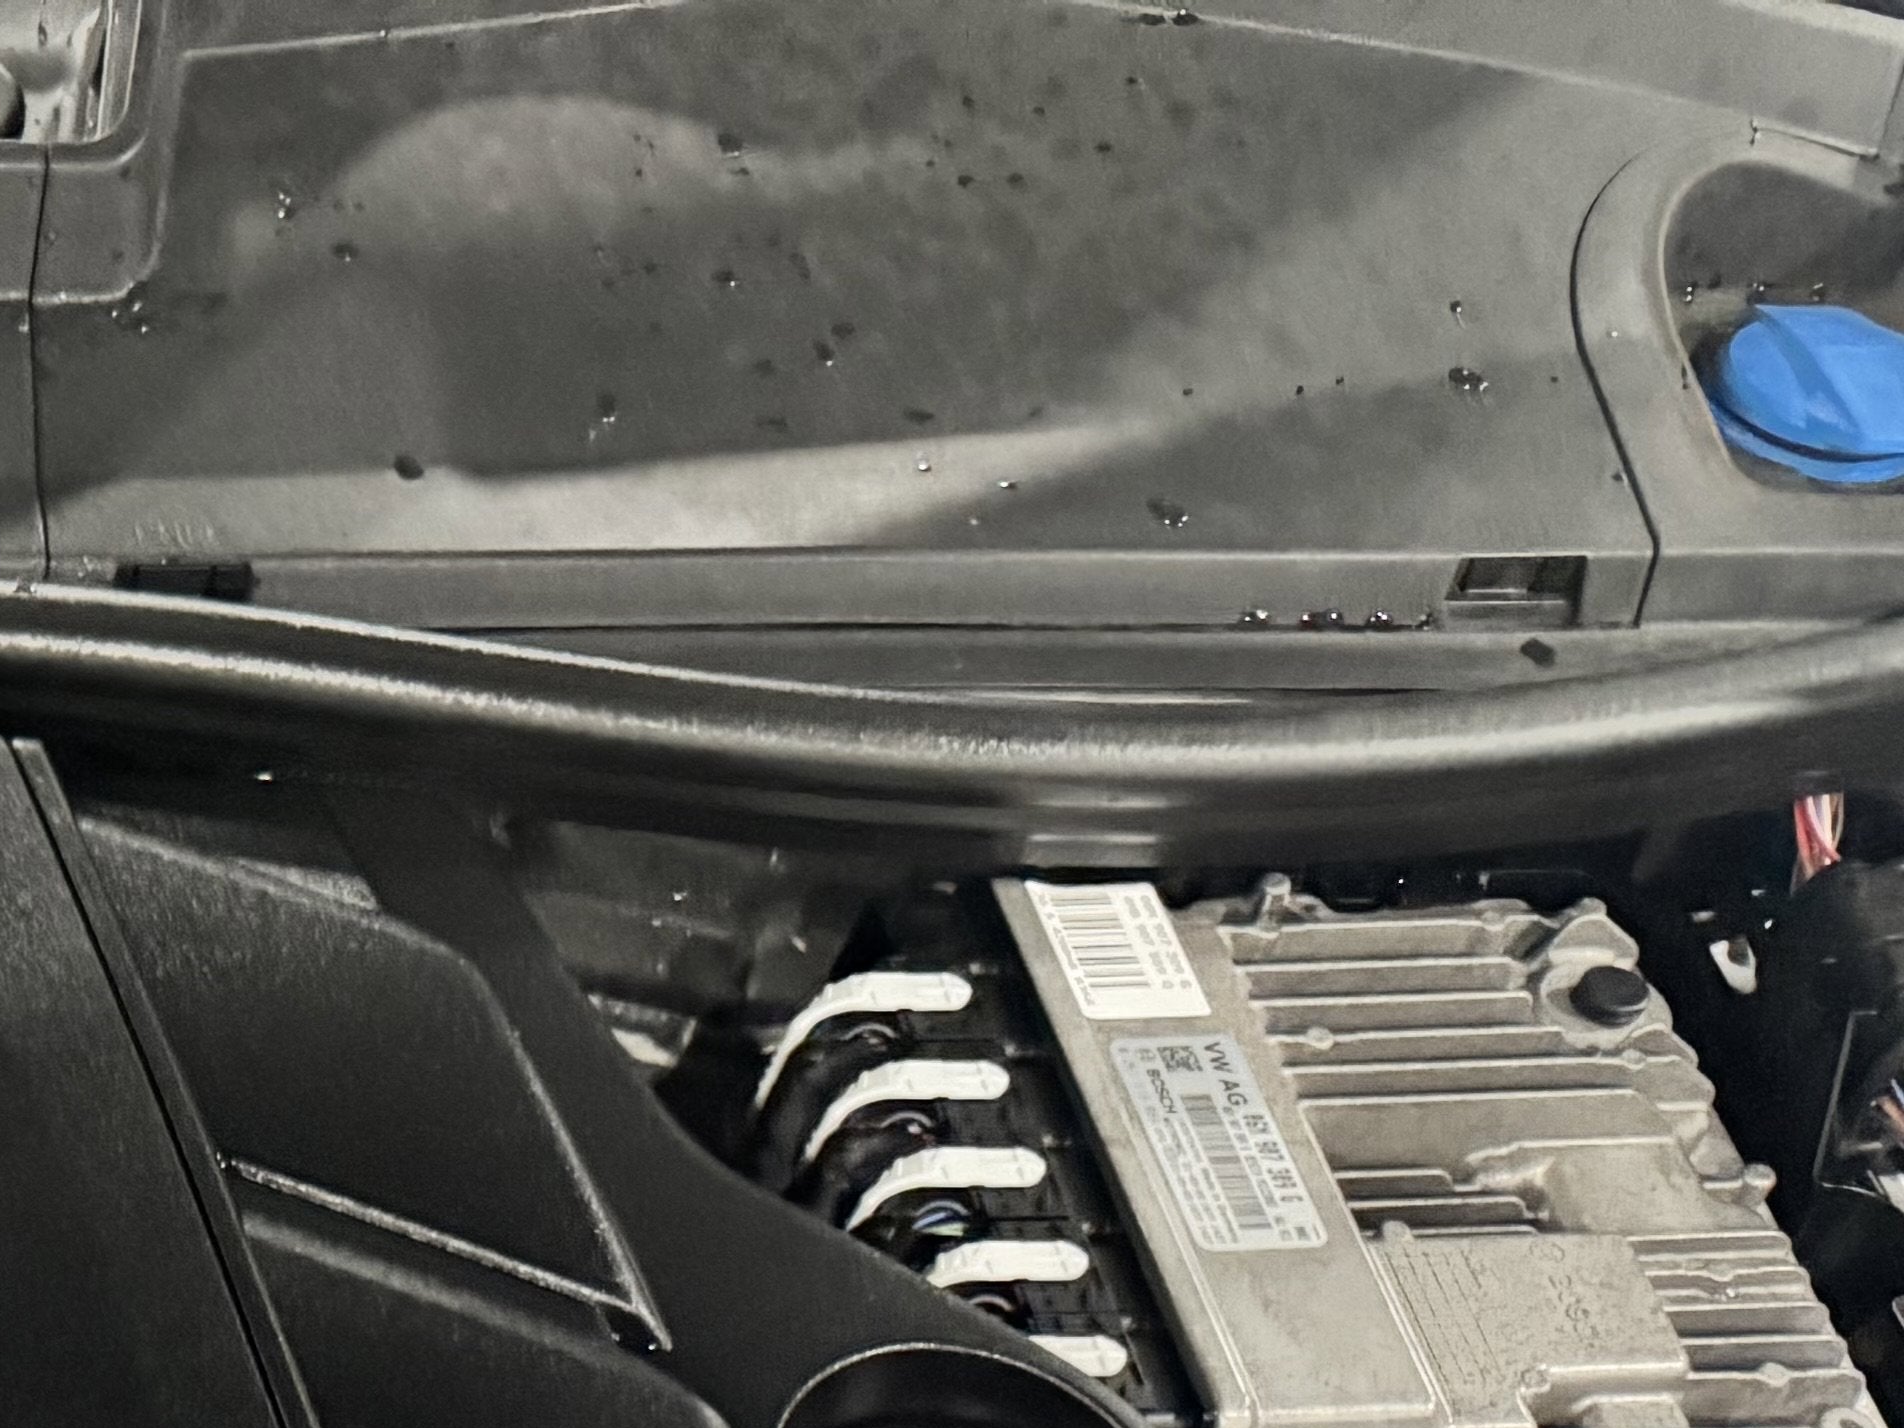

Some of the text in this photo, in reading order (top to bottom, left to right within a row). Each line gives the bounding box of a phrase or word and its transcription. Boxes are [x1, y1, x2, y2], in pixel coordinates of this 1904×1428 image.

[1203, 1041, 1233, 1074] VW
[1145, 1068, 1179, 1115] BOSCH
[1217, 1079, 1249, 1107] AG
